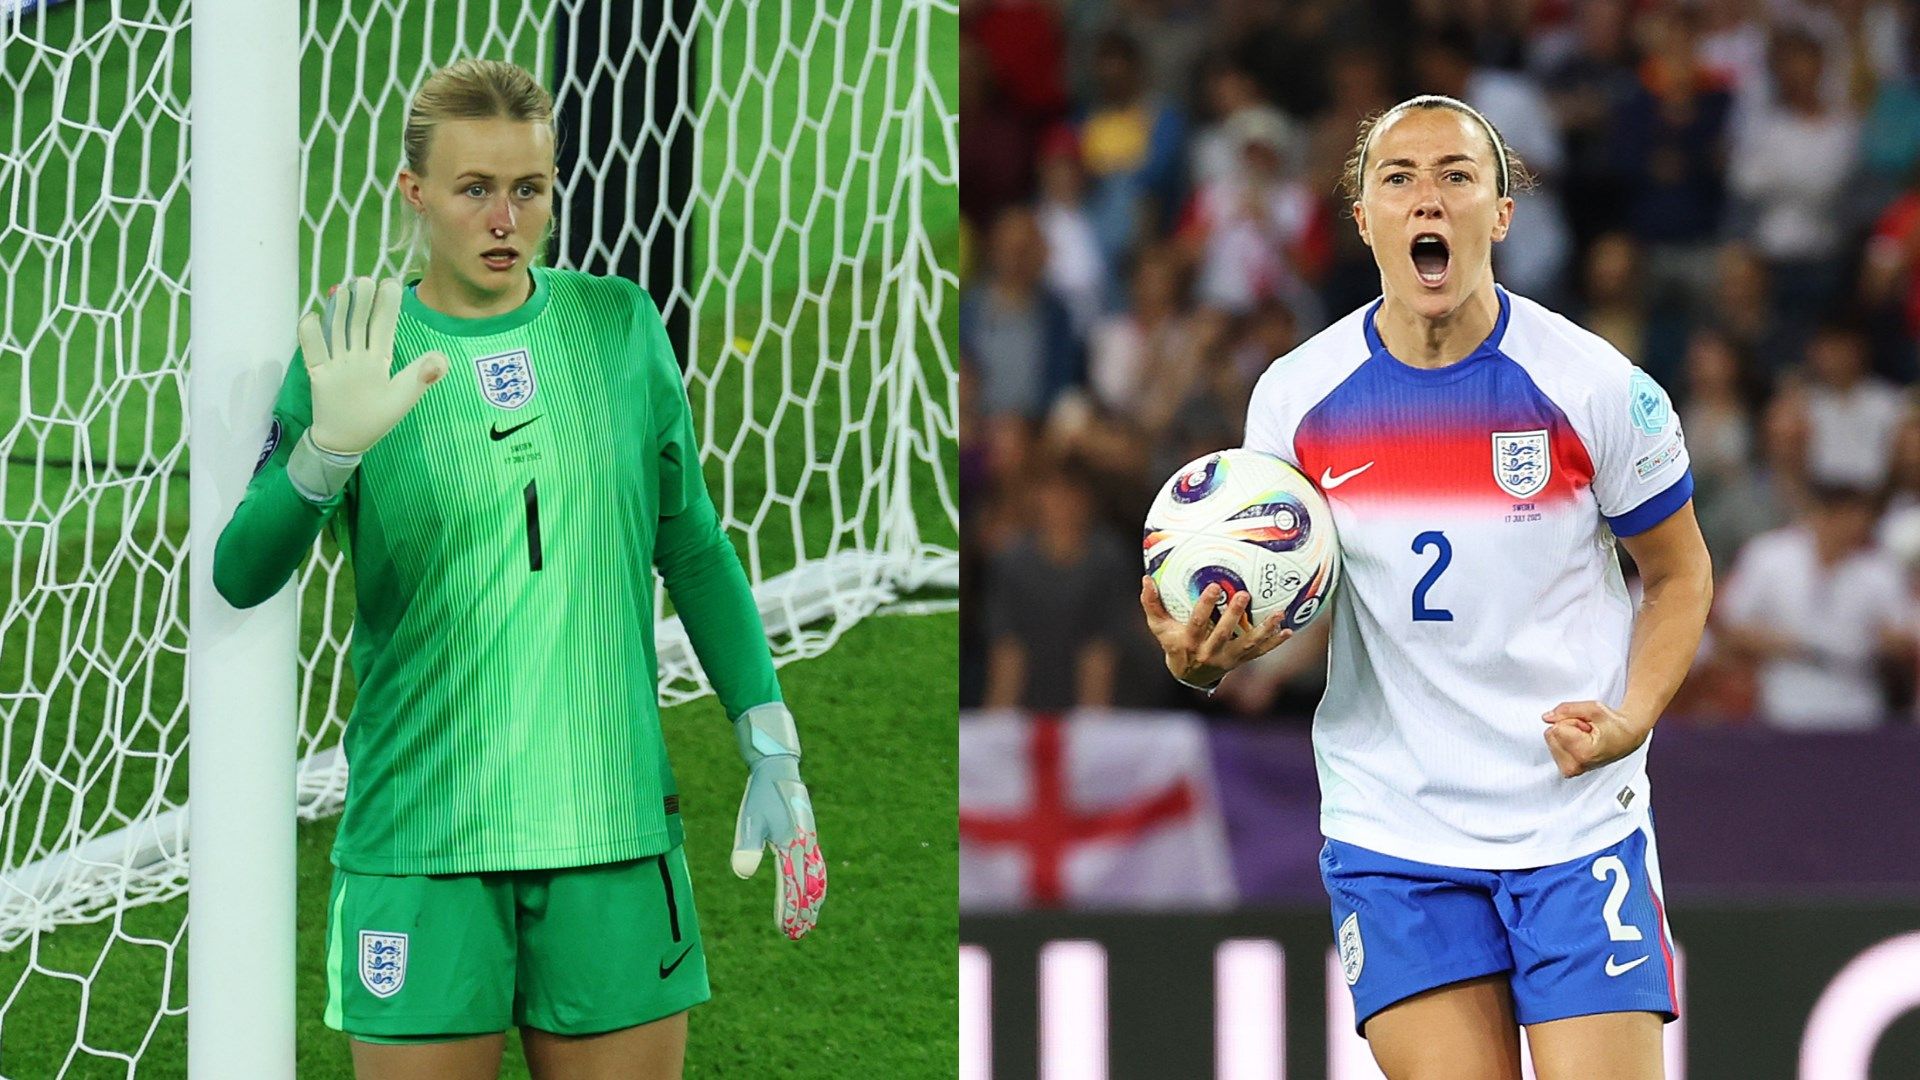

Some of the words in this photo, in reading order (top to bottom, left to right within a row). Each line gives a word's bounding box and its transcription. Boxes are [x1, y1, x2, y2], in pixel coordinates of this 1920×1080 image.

[523, 477, 543, 572] 1
[1504, 515, 1511, 523] 17
[1527, 513, 1541, 521] 2025
[1512, 503, 1535, 511] SWEDEN
[1411, 531, 1454, 621] 2
[658, 853, 681, 943] 1
[1591, 855, 1643, 941] 2
